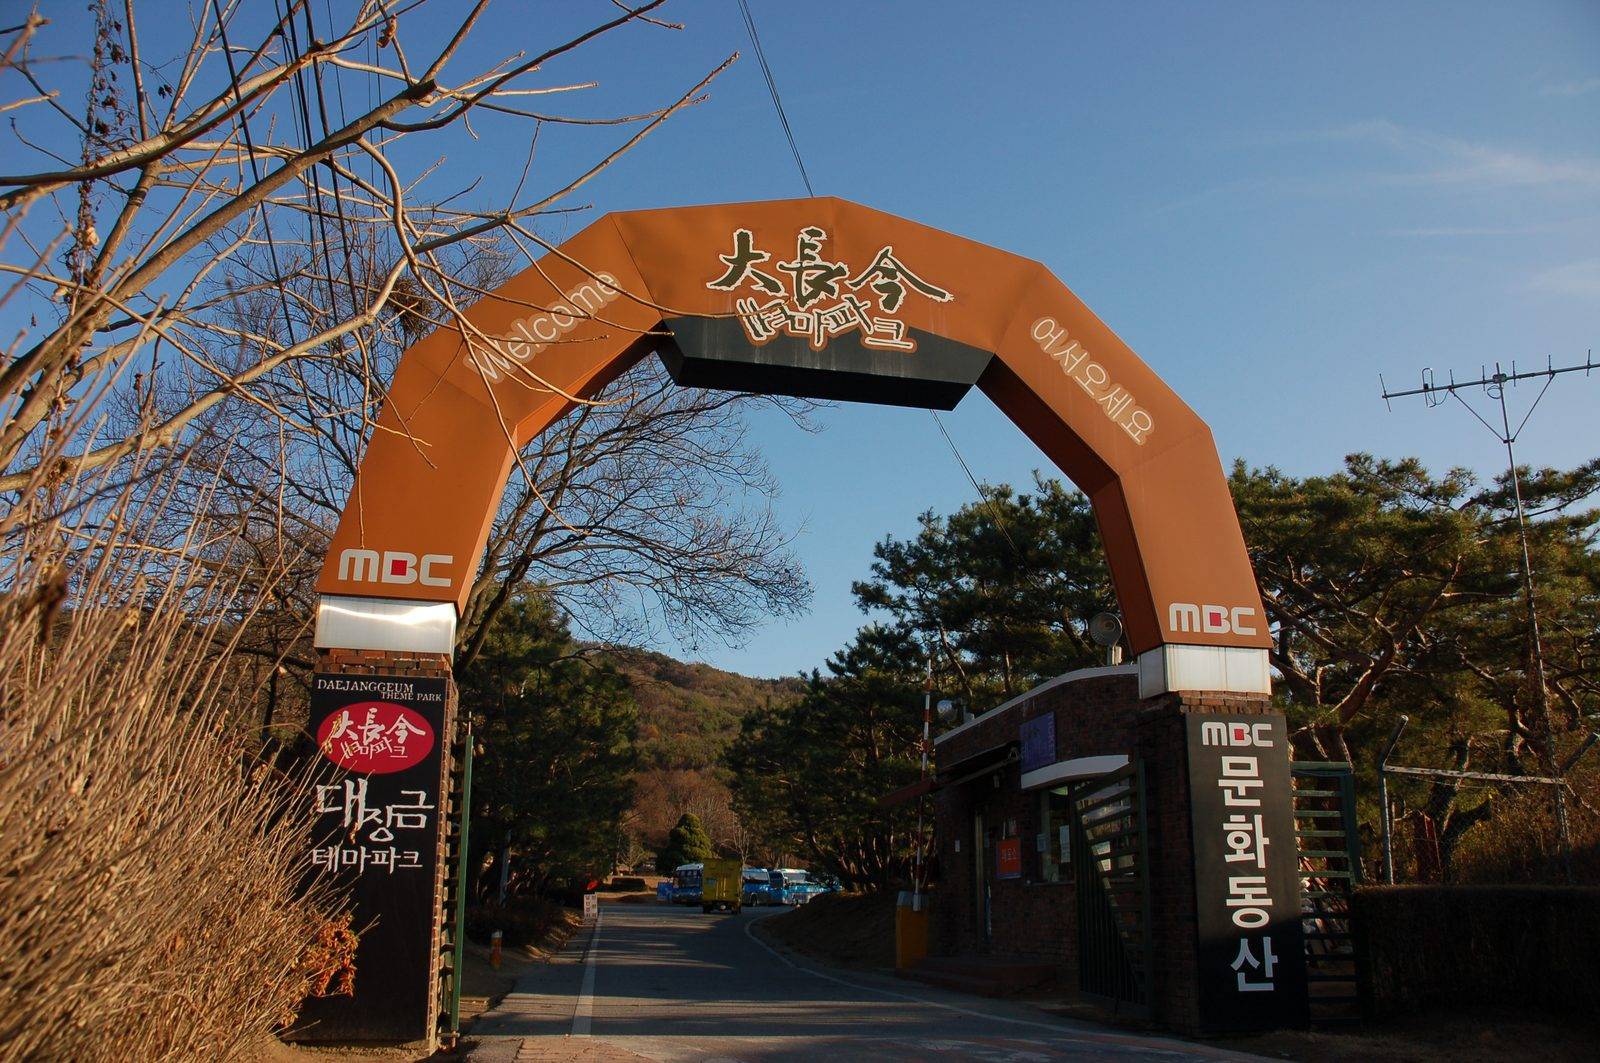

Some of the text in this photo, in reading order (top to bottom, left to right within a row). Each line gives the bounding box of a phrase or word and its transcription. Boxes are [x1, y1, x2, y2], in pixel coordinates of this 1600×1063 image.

[706, 227, 955, 314] 大長今
[468, 274, 618, 380] Welcome
[736, 295, 914, 348] 테마파크
[1034, 318, 1152, 443] 어서오세요
[338, 548, 453, 587] MBC
[1169, 603, 1257, 636] MBC
[317, 679, 414, 693] DAEJANGGEUM
[380, 691, 442, 702] THEME PARK
[1201, 721, 1274, 748] MBC
[316, 778, 435, 842] 대장금
[312, 845, 423, 874] 테마파크
[1218, 755, 1279, 992] 문화동산
